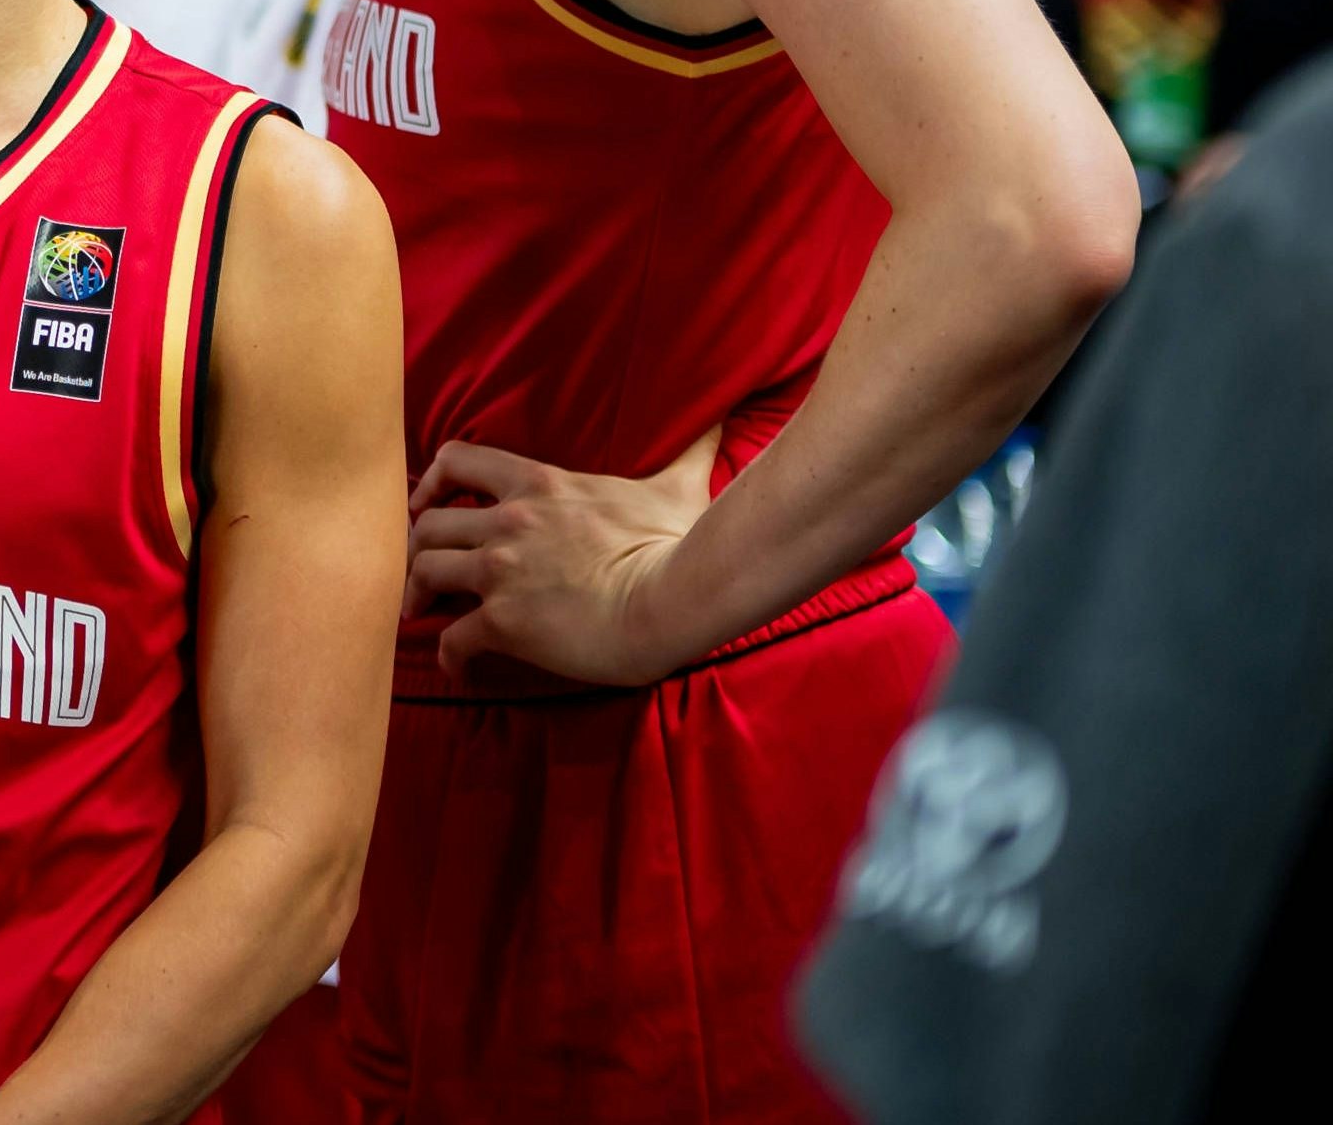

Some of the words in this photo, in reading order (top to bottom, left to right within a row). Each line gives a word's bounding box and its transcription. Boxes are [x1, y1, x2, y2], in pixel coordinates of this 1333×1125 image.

[33, 318, 94, 352] FIBA
[23, 369, 36, 380] We
[37, 371, 52, 382] Are
[53, 373, 93, 388] Basketball
